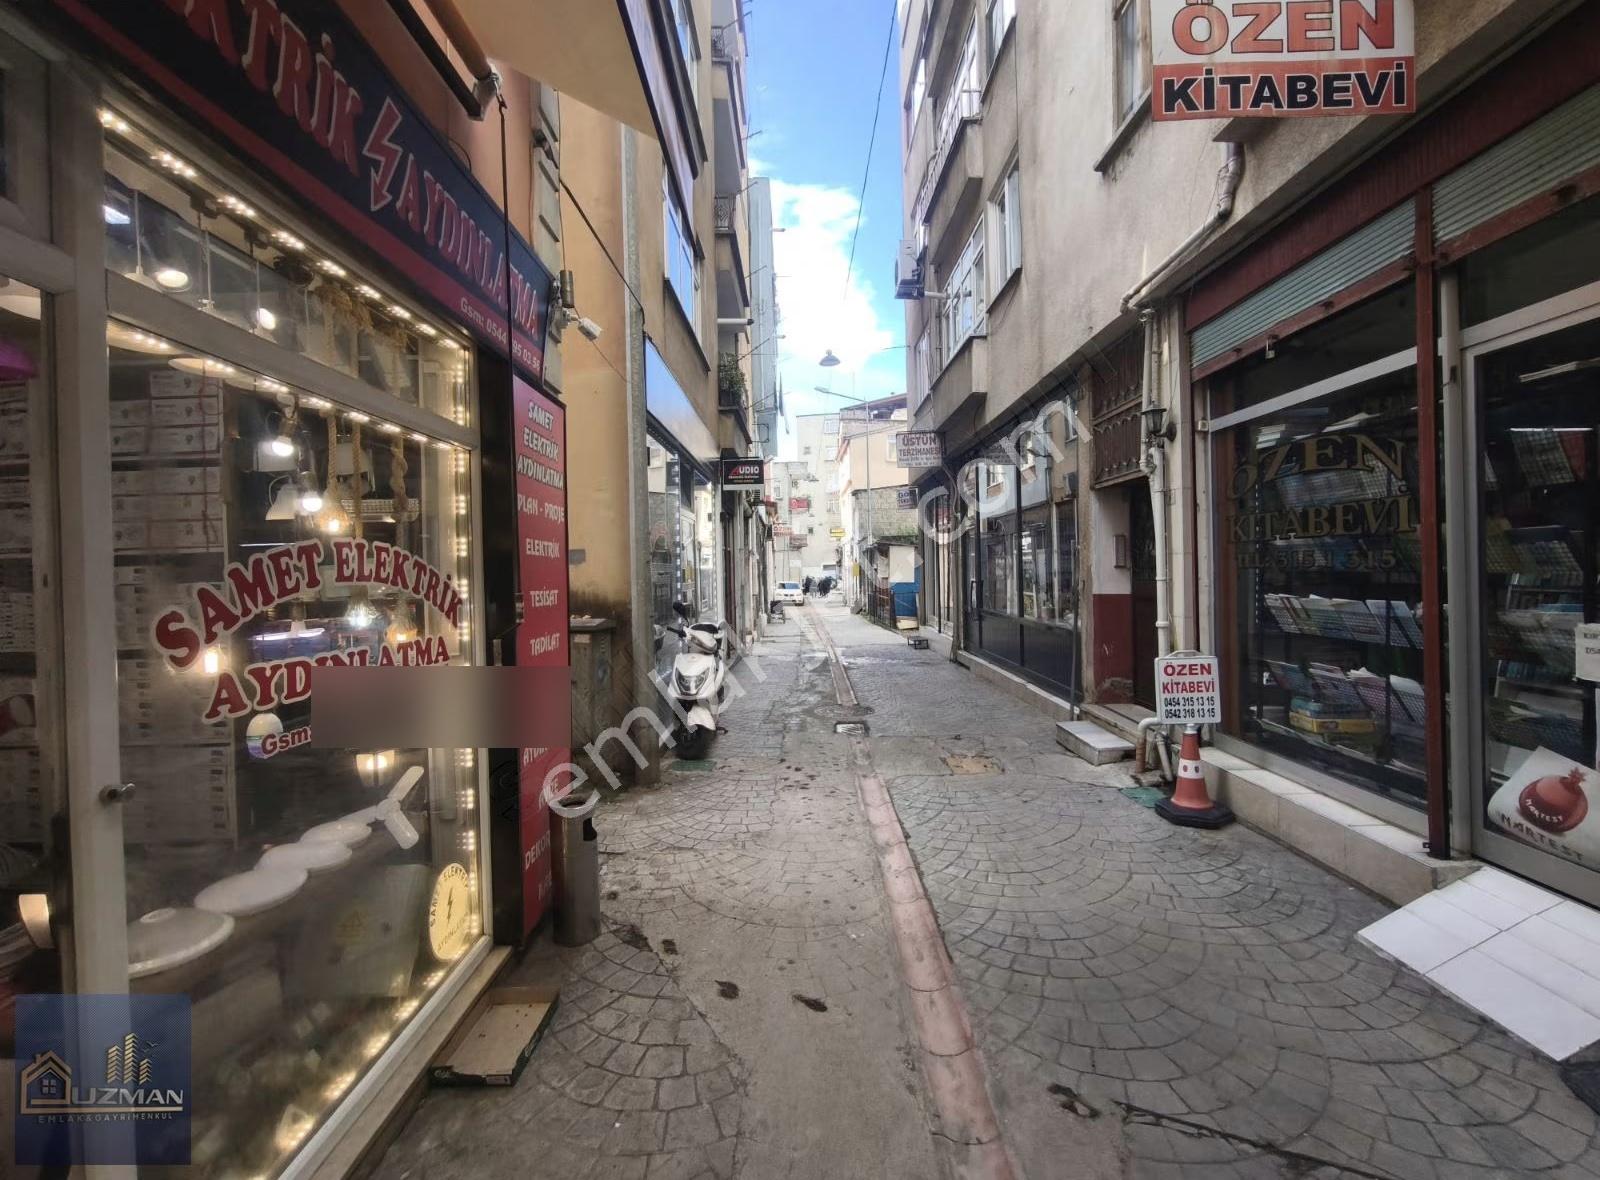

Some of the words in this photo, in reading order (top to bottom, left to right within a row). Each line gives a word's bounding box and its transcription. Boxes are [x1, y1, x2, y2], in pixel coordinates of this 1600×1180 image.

[1172, 0, 1395, 55] ÖZEN
[1162, 61, 1406, 114] KİTABEVİ
[528, 401, 554, 430] SAMET
[523, 426, 559, 461] ELEKTRİK
[517, 454, 564, 490] AYDINLATMA
[730, 464, 760, 476] AUDIO
[1228, 433, 1407, 499] ÖZEN
[517, 493, 538, 515] PLAN
[544, 502, 565, 523] PROJE
[526, 537, 560, 558] ELEKTRİK
[155, 542, 323, 669] SAMET
[333, 541, 464, 629] ELEKTRİK
[530, 586, 559, 607] TESİSAT
[530, 633, 560, 656] TADİLAT
[204, 636, 451, 719] AYDATMA
[1163, 662, 1212, 677] ÖZEN
[1162, 678, 1215, 694] KİTABEVİ
[1164, 697, 1181, 707] 0454
[1182, 697, 1194, 707] 315
[1196, 696, 1205, 706] 13
[1206, 696, 1215, 706] 15
[1164, 708, 1181, 718] 0542
[1182, 708, 1195, 718] 318
[1197, 708, 1205, 718] 13
[1207, 708, 1216, 718] 15
